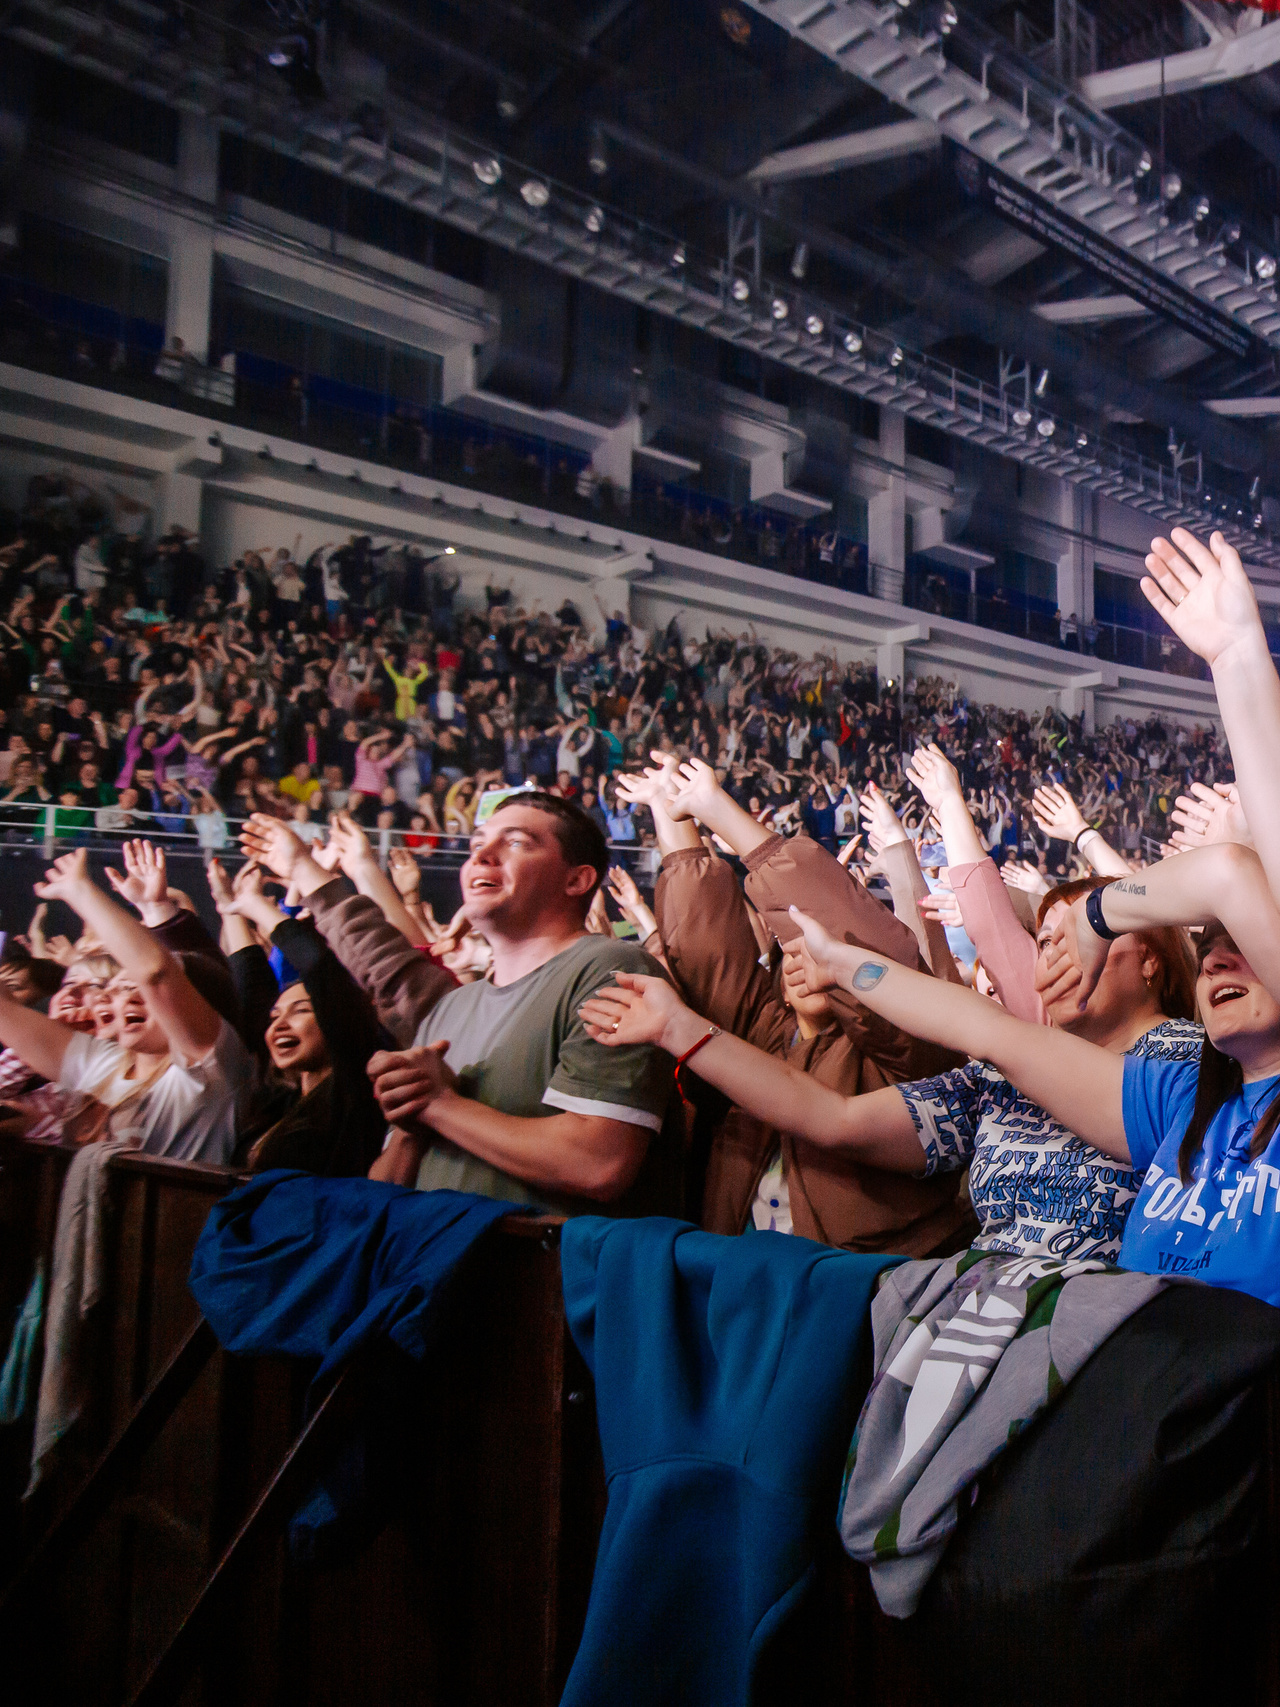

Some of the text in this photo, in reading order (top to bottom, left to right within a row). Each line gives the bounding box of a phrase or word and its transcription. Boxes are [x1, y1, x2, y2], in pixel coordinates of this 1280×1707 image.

[992, 1109, 1044, 1132] Love
[984, 1145, 1084, 1168] Love you
[1012, 1223, 1046, 1244] you
